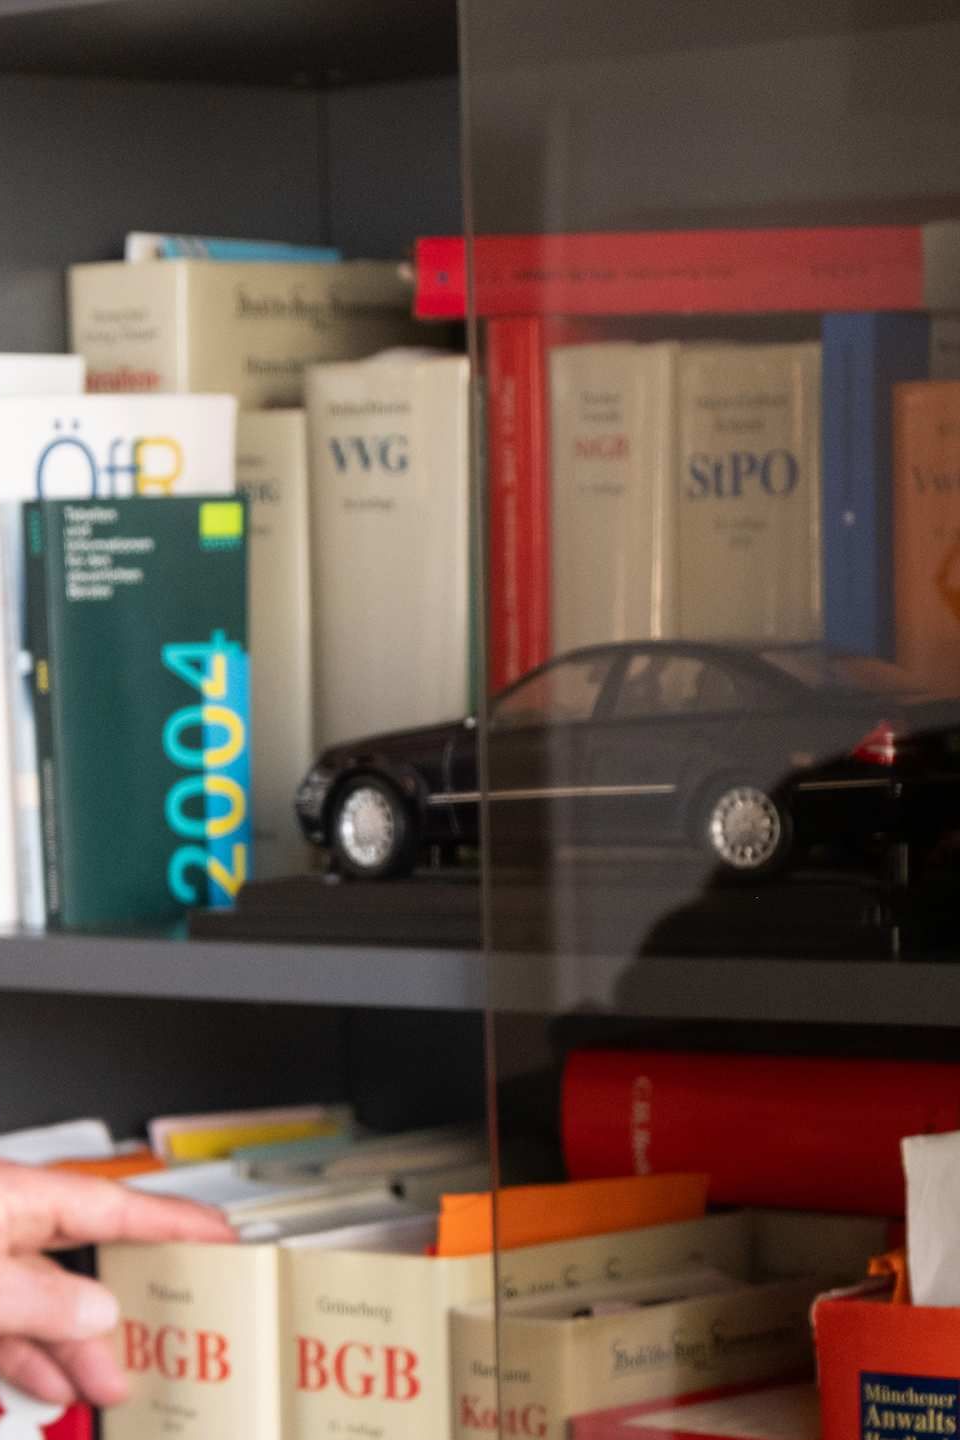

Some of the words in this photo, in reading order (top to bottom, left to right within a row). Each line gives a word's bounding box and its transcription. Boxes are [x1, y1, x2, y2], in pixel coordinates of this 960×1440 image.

[688, 449, 799, 501] StPO
[161, 628, 246, 906] 2004
[121, 1318, 232, 1384] BGB
[294, 1334, 422, 1402] BGB
[864, 1384, 957, 1408] Münchener
[866, 1404, 958, 1434] Anwalts
